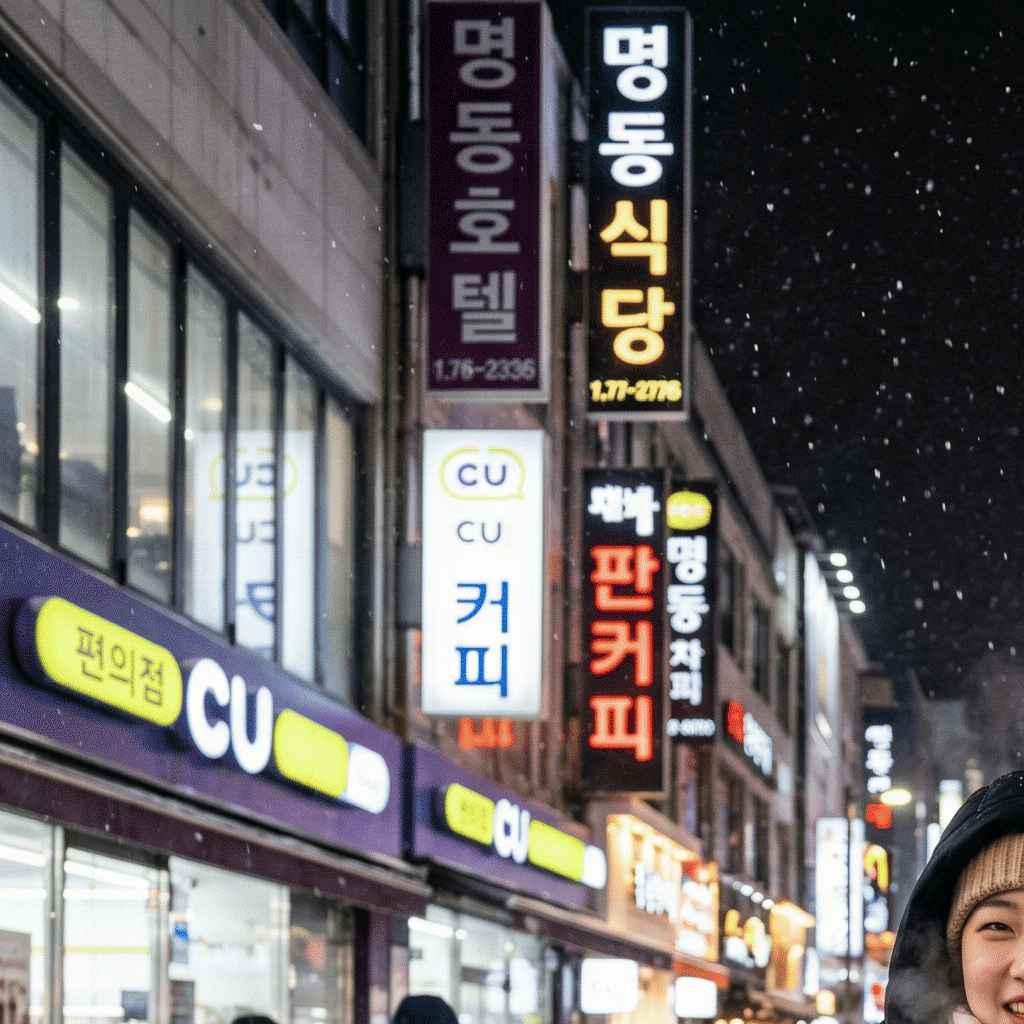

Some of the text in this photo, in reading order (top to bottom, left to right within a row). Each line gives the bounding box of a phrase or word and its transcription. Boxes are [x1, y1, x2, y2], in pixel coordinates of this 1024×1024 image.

[449, 17, 521, 345] 명동호텔
[599, 24, 676, 366] 명동식당
[457, 463, 507, 486] CU
[456, 520, 502, 544] CU
[75, 625, 164, 707] 편의점
[454, 580, 509, 698] 커피
[187, 658, 273, 774] CU
[493, 798, 531, 864] CU
